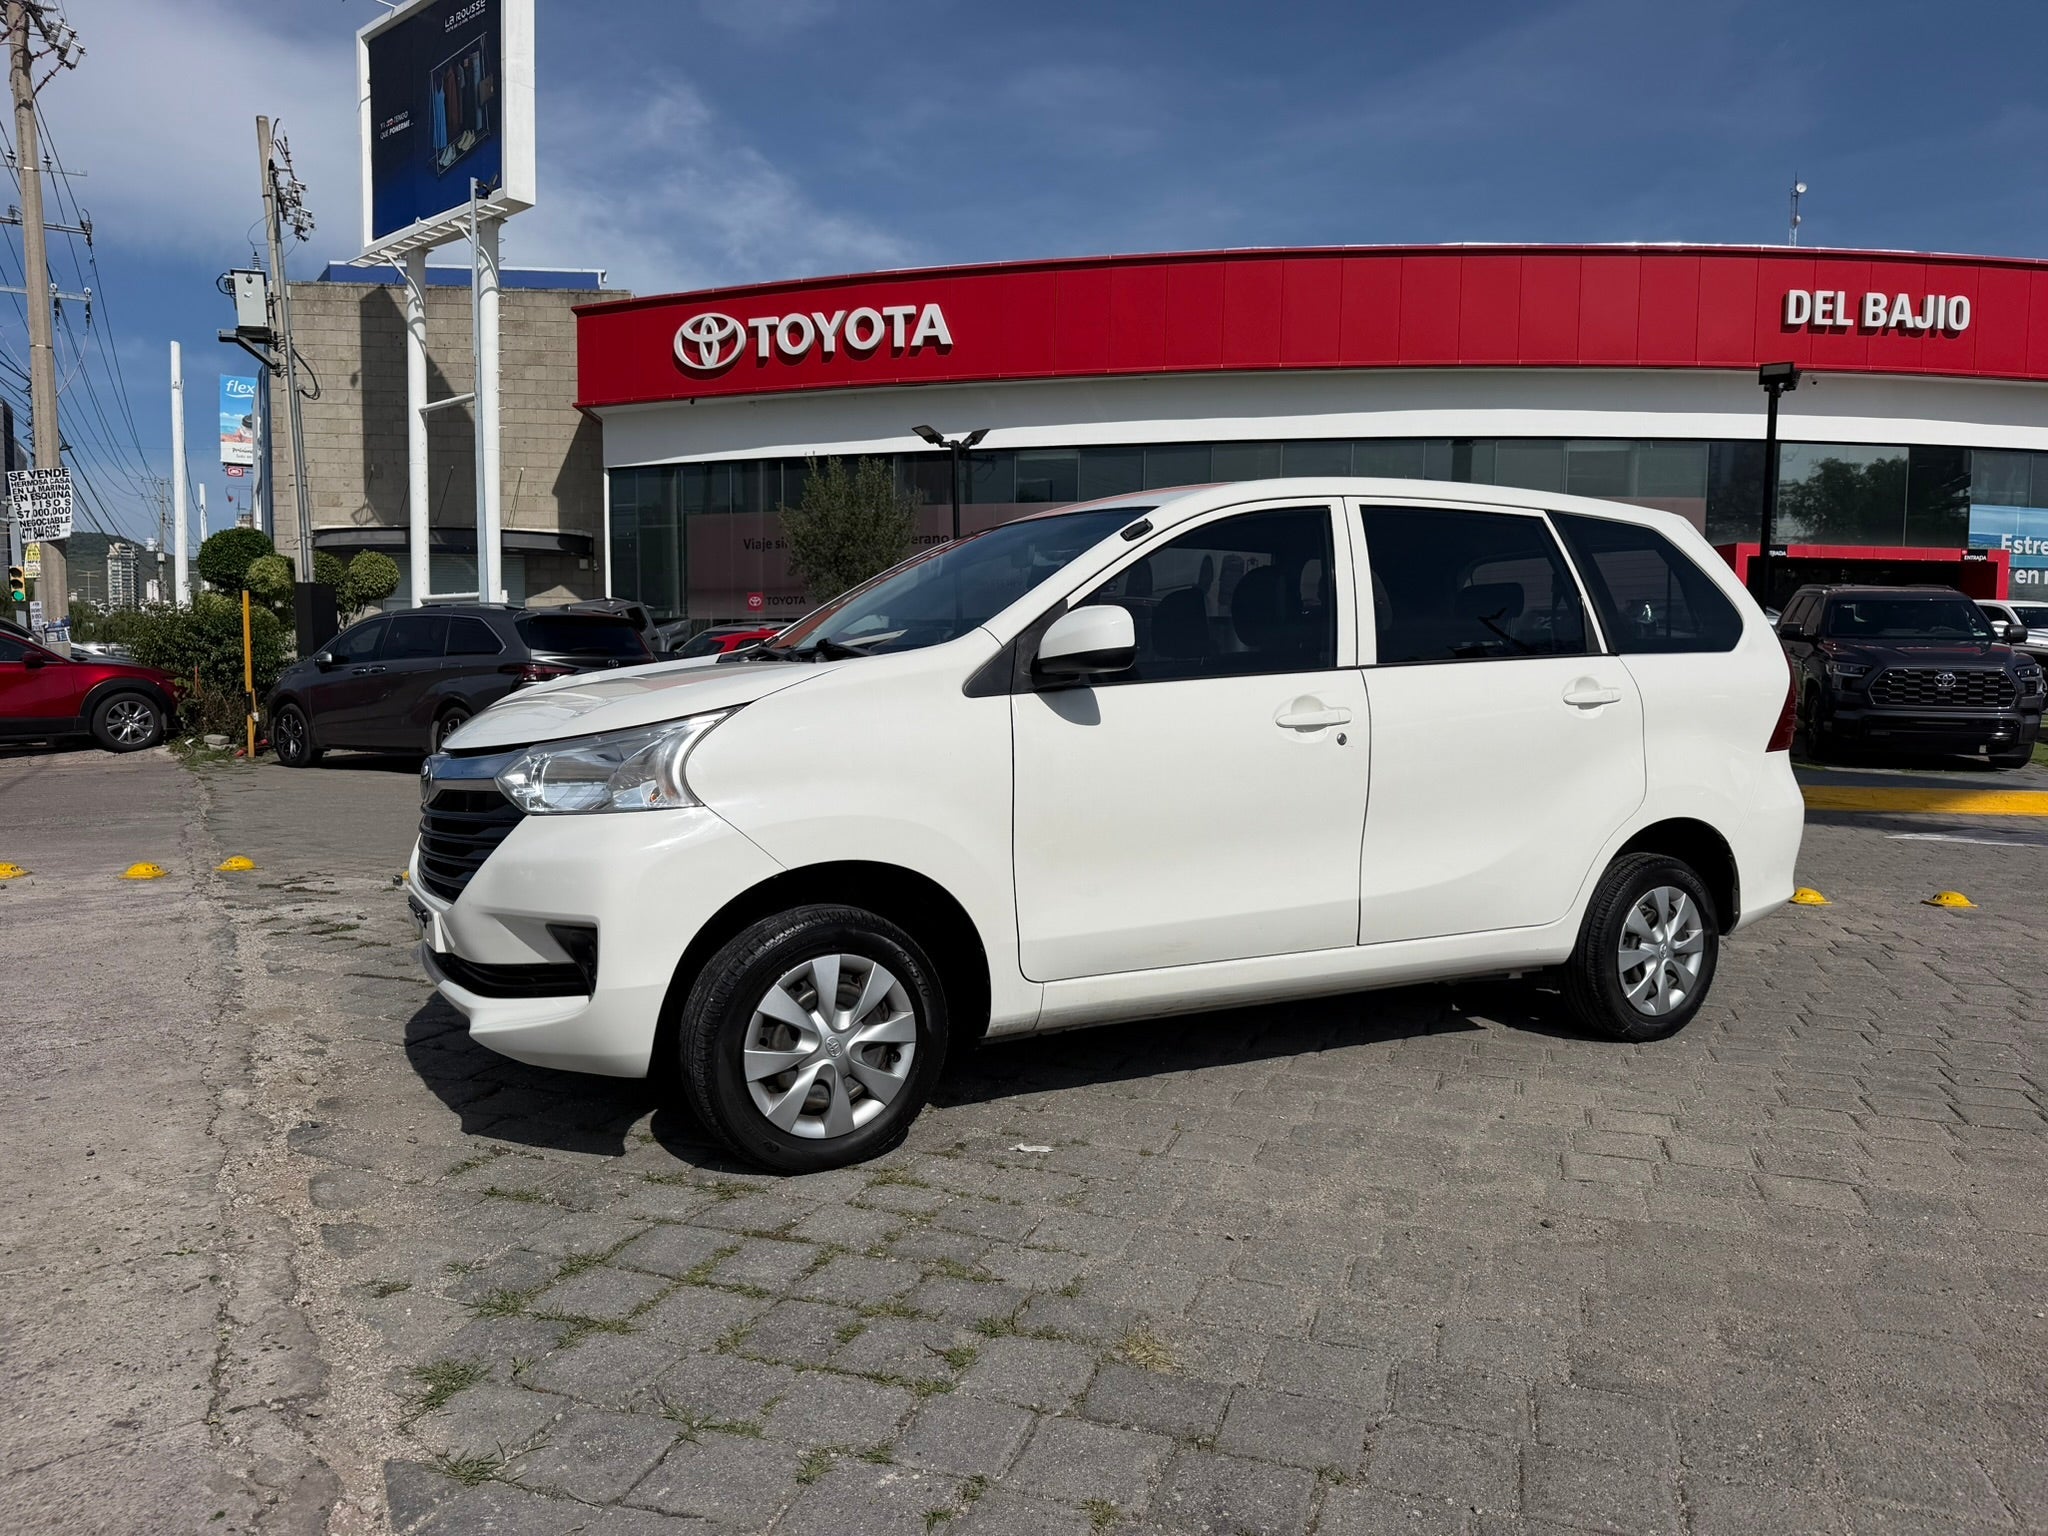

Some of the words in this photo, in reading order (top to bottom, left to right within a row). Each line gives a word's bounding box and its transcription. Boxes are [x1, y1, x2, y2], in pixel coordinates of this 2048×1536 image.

[1786, 289, 1854, 326] DEL
[1863, 292, 1971, 331] BAJIO
[748, 303, 954, 358] TOYOTA
[226, 380, 256, 395] flex
[9, 471, 26, 481] SE
[28, 468, 70, 479] VENDE
[11, 479, 48, 488] HERMOSA
[38, 484, 71, 492] MARINA
[13, 493, 28, 502] EN
[30, 491, 71, 501] ESQUINA
[19, 516, 71, 528] NEGOCIABLE
[21, 528, 32, 540] 477
[34, 526, 45, 539] 844
[45, 525, 61, 538] 6325
[743, 537, 773, 552] Viaje
[910, 535, 950, 545] erano
[1964, 554, 1987, 562] ENTRADA
[2014, 569, 2040, 584] en
[766, 596, 806, 606] TOYOTA
